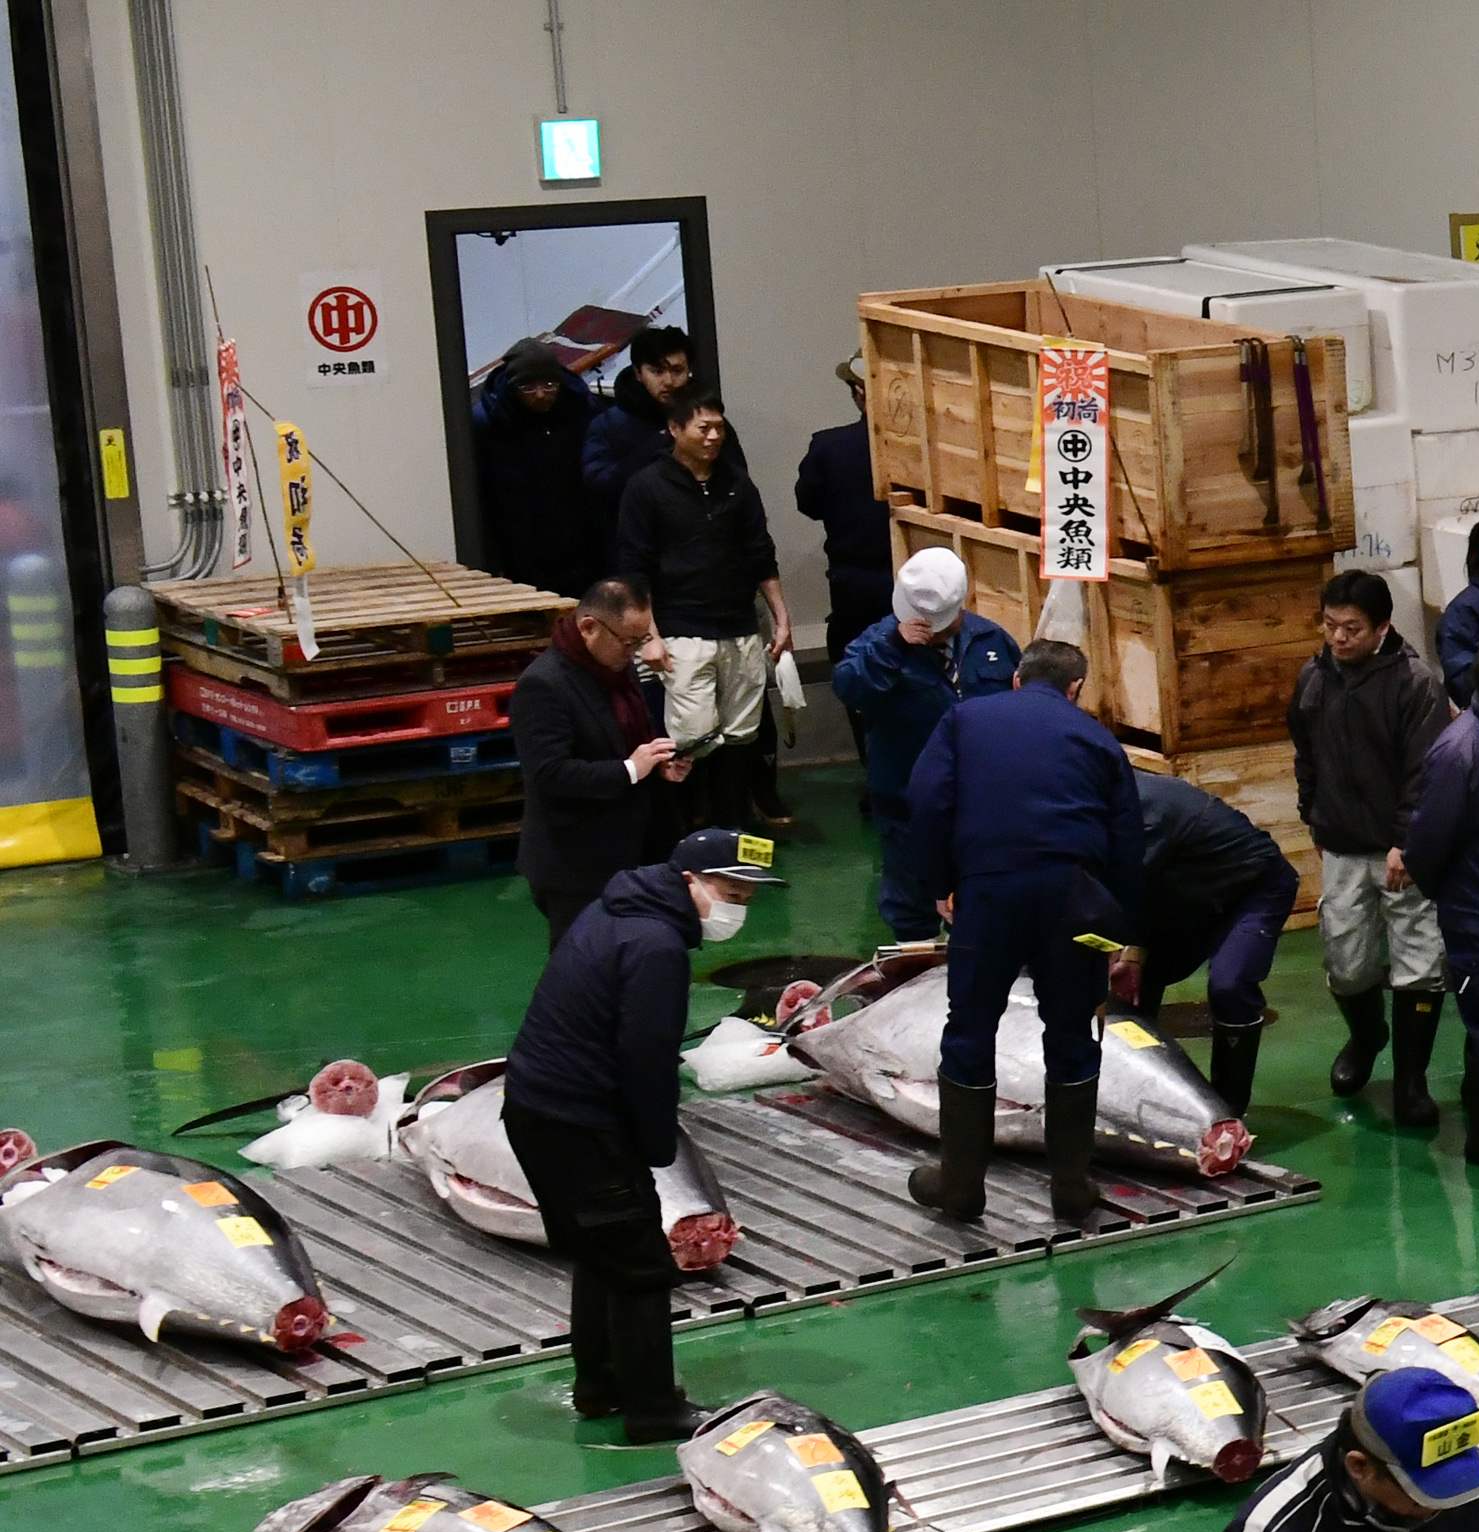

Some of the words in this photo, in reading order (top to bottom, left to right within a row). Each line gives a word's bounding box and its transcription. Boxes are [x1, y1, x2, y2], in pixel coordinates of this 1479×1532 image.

[317, 360, 376, 377] 中央魚類
[1052, 395, 1100, 424] 初荷
[1057, 467, 1096, 571] 中央魚類
